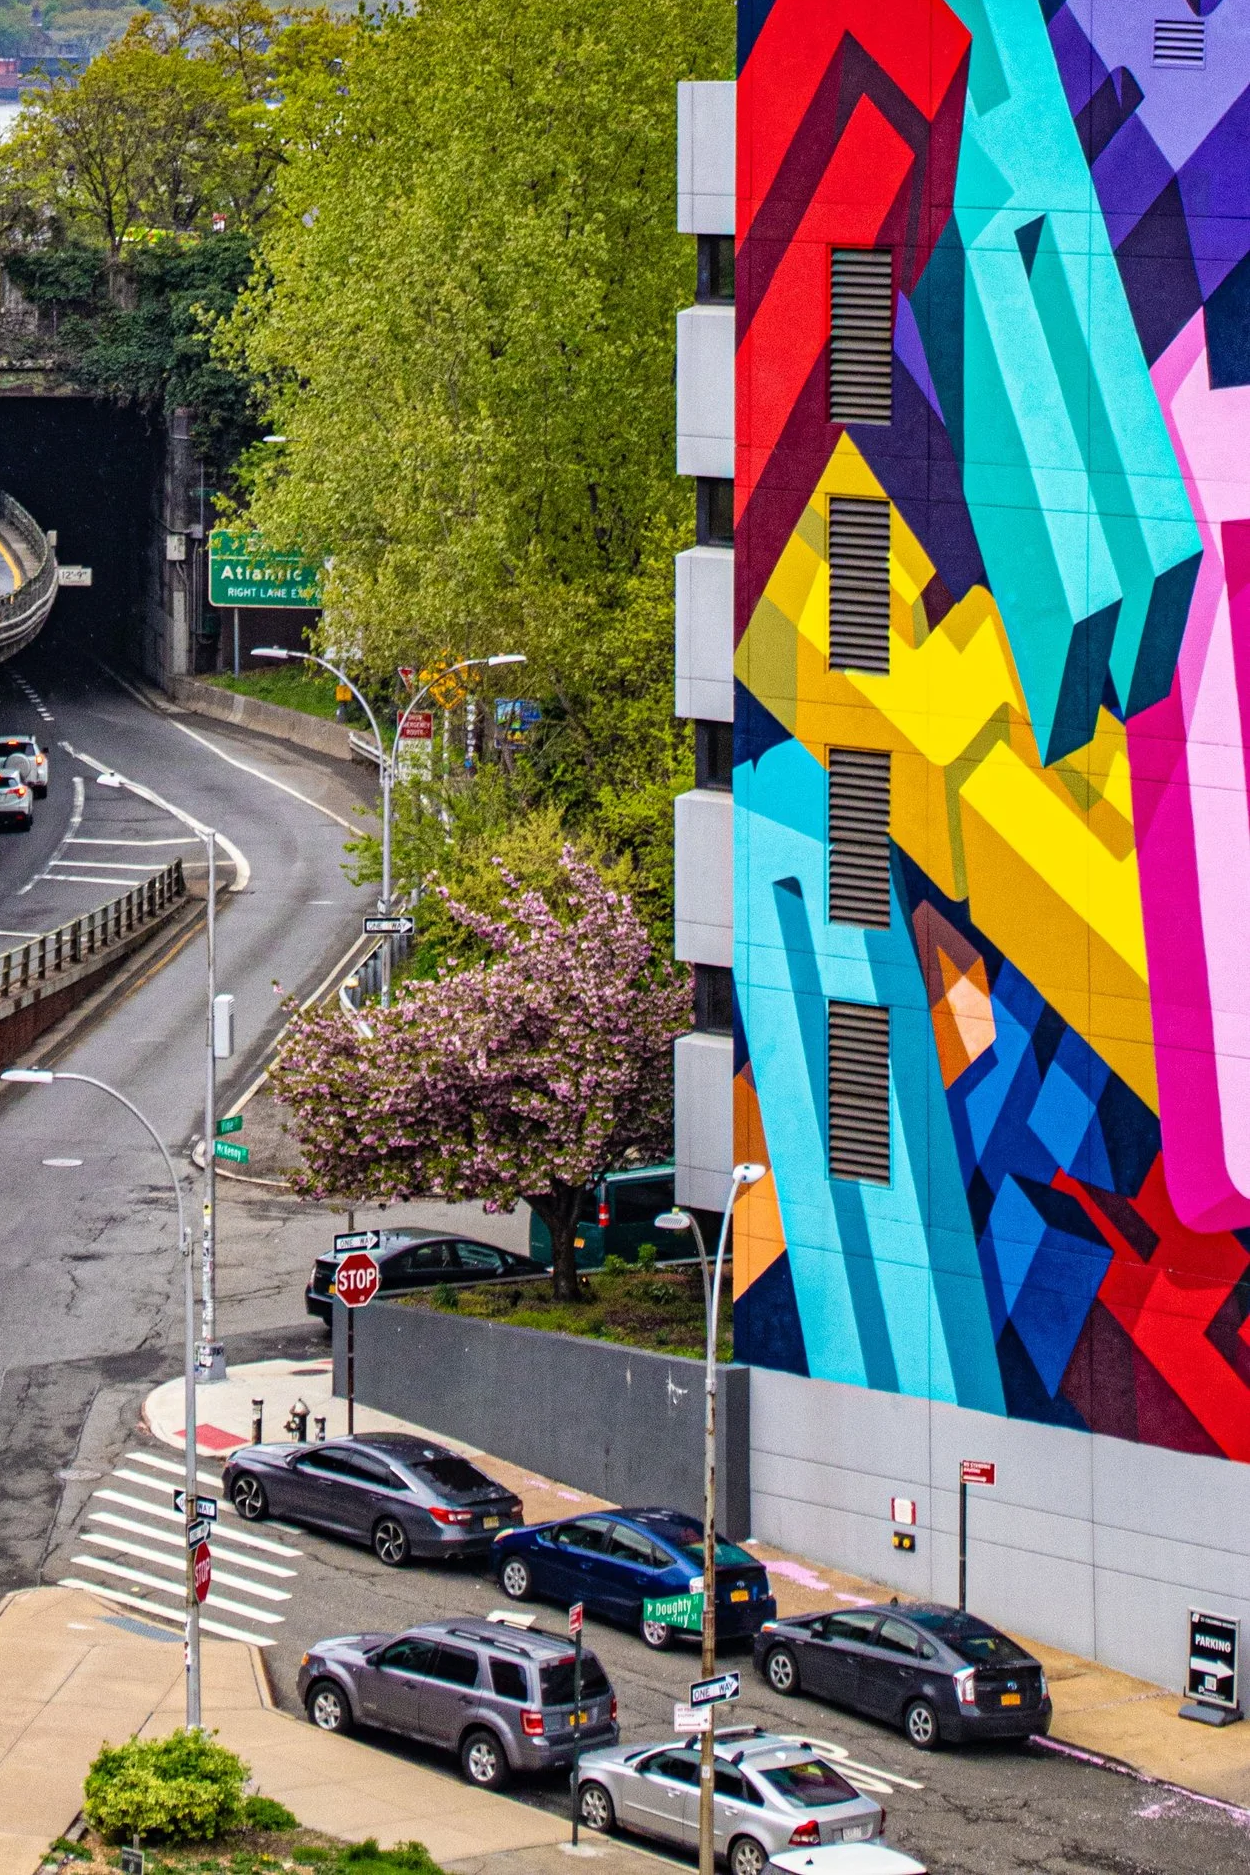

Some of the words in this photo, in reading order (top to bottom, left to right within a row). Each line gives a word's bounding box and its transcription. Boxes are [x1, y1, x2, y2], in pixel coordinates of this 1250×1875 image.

[227, 588, 256, 597] RIGHT
[260, 588, 287, 598] LANE
[368, 922, 382, 930] ONE
[392, 922, 406, 930] WAY
[340, 1238, 353, 1248] ONE
[359, 1236, 374, 1245] WAY
[338, 1268, 375, 1292] STOP
[196, 1503, 212, 1515] WAY
[195, 1557, 210, 1588] STOP
[655, 1598, 691, 1616] Doughty
[1195, 1633, 1231, 1653] PARKING
[694, 1687, 710, 1700] ONE
[718, 1681, 734, 1693] WAY
